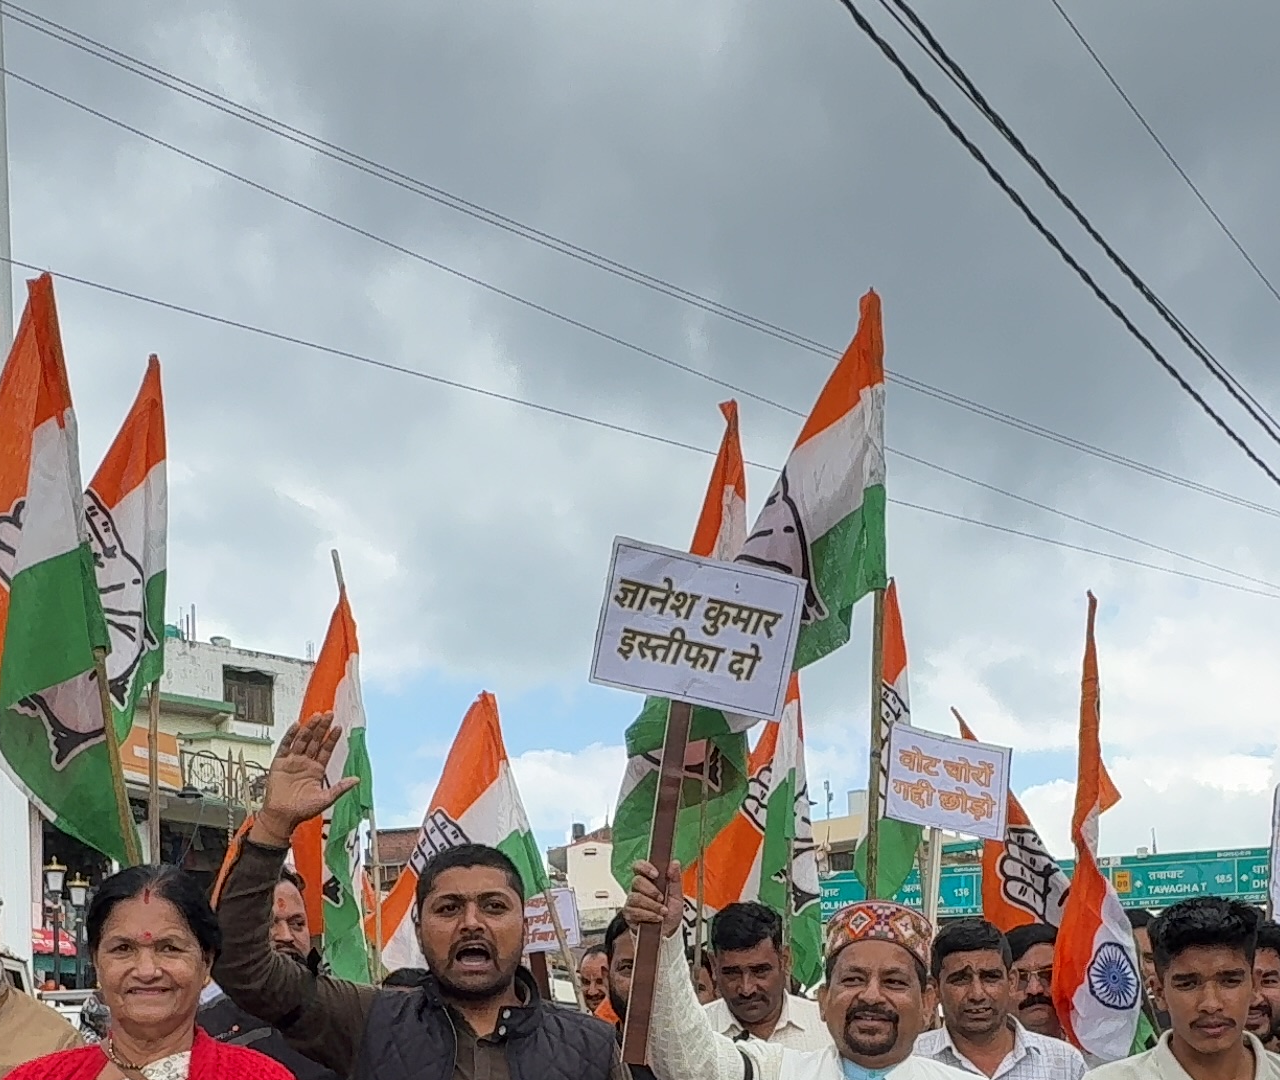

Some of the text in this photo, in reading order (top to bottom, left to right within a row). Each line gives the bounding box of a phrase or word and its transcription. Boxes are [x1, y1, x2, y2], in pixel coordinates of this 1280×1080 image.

[614, 577, 783, 639] ज्ञानेश कुमार
[617, 627, 762, 681] इस्तीफा दो
[899, 745, 994, 787] वोट चोरों
[938, 786, 997, 821] छोड़ो
